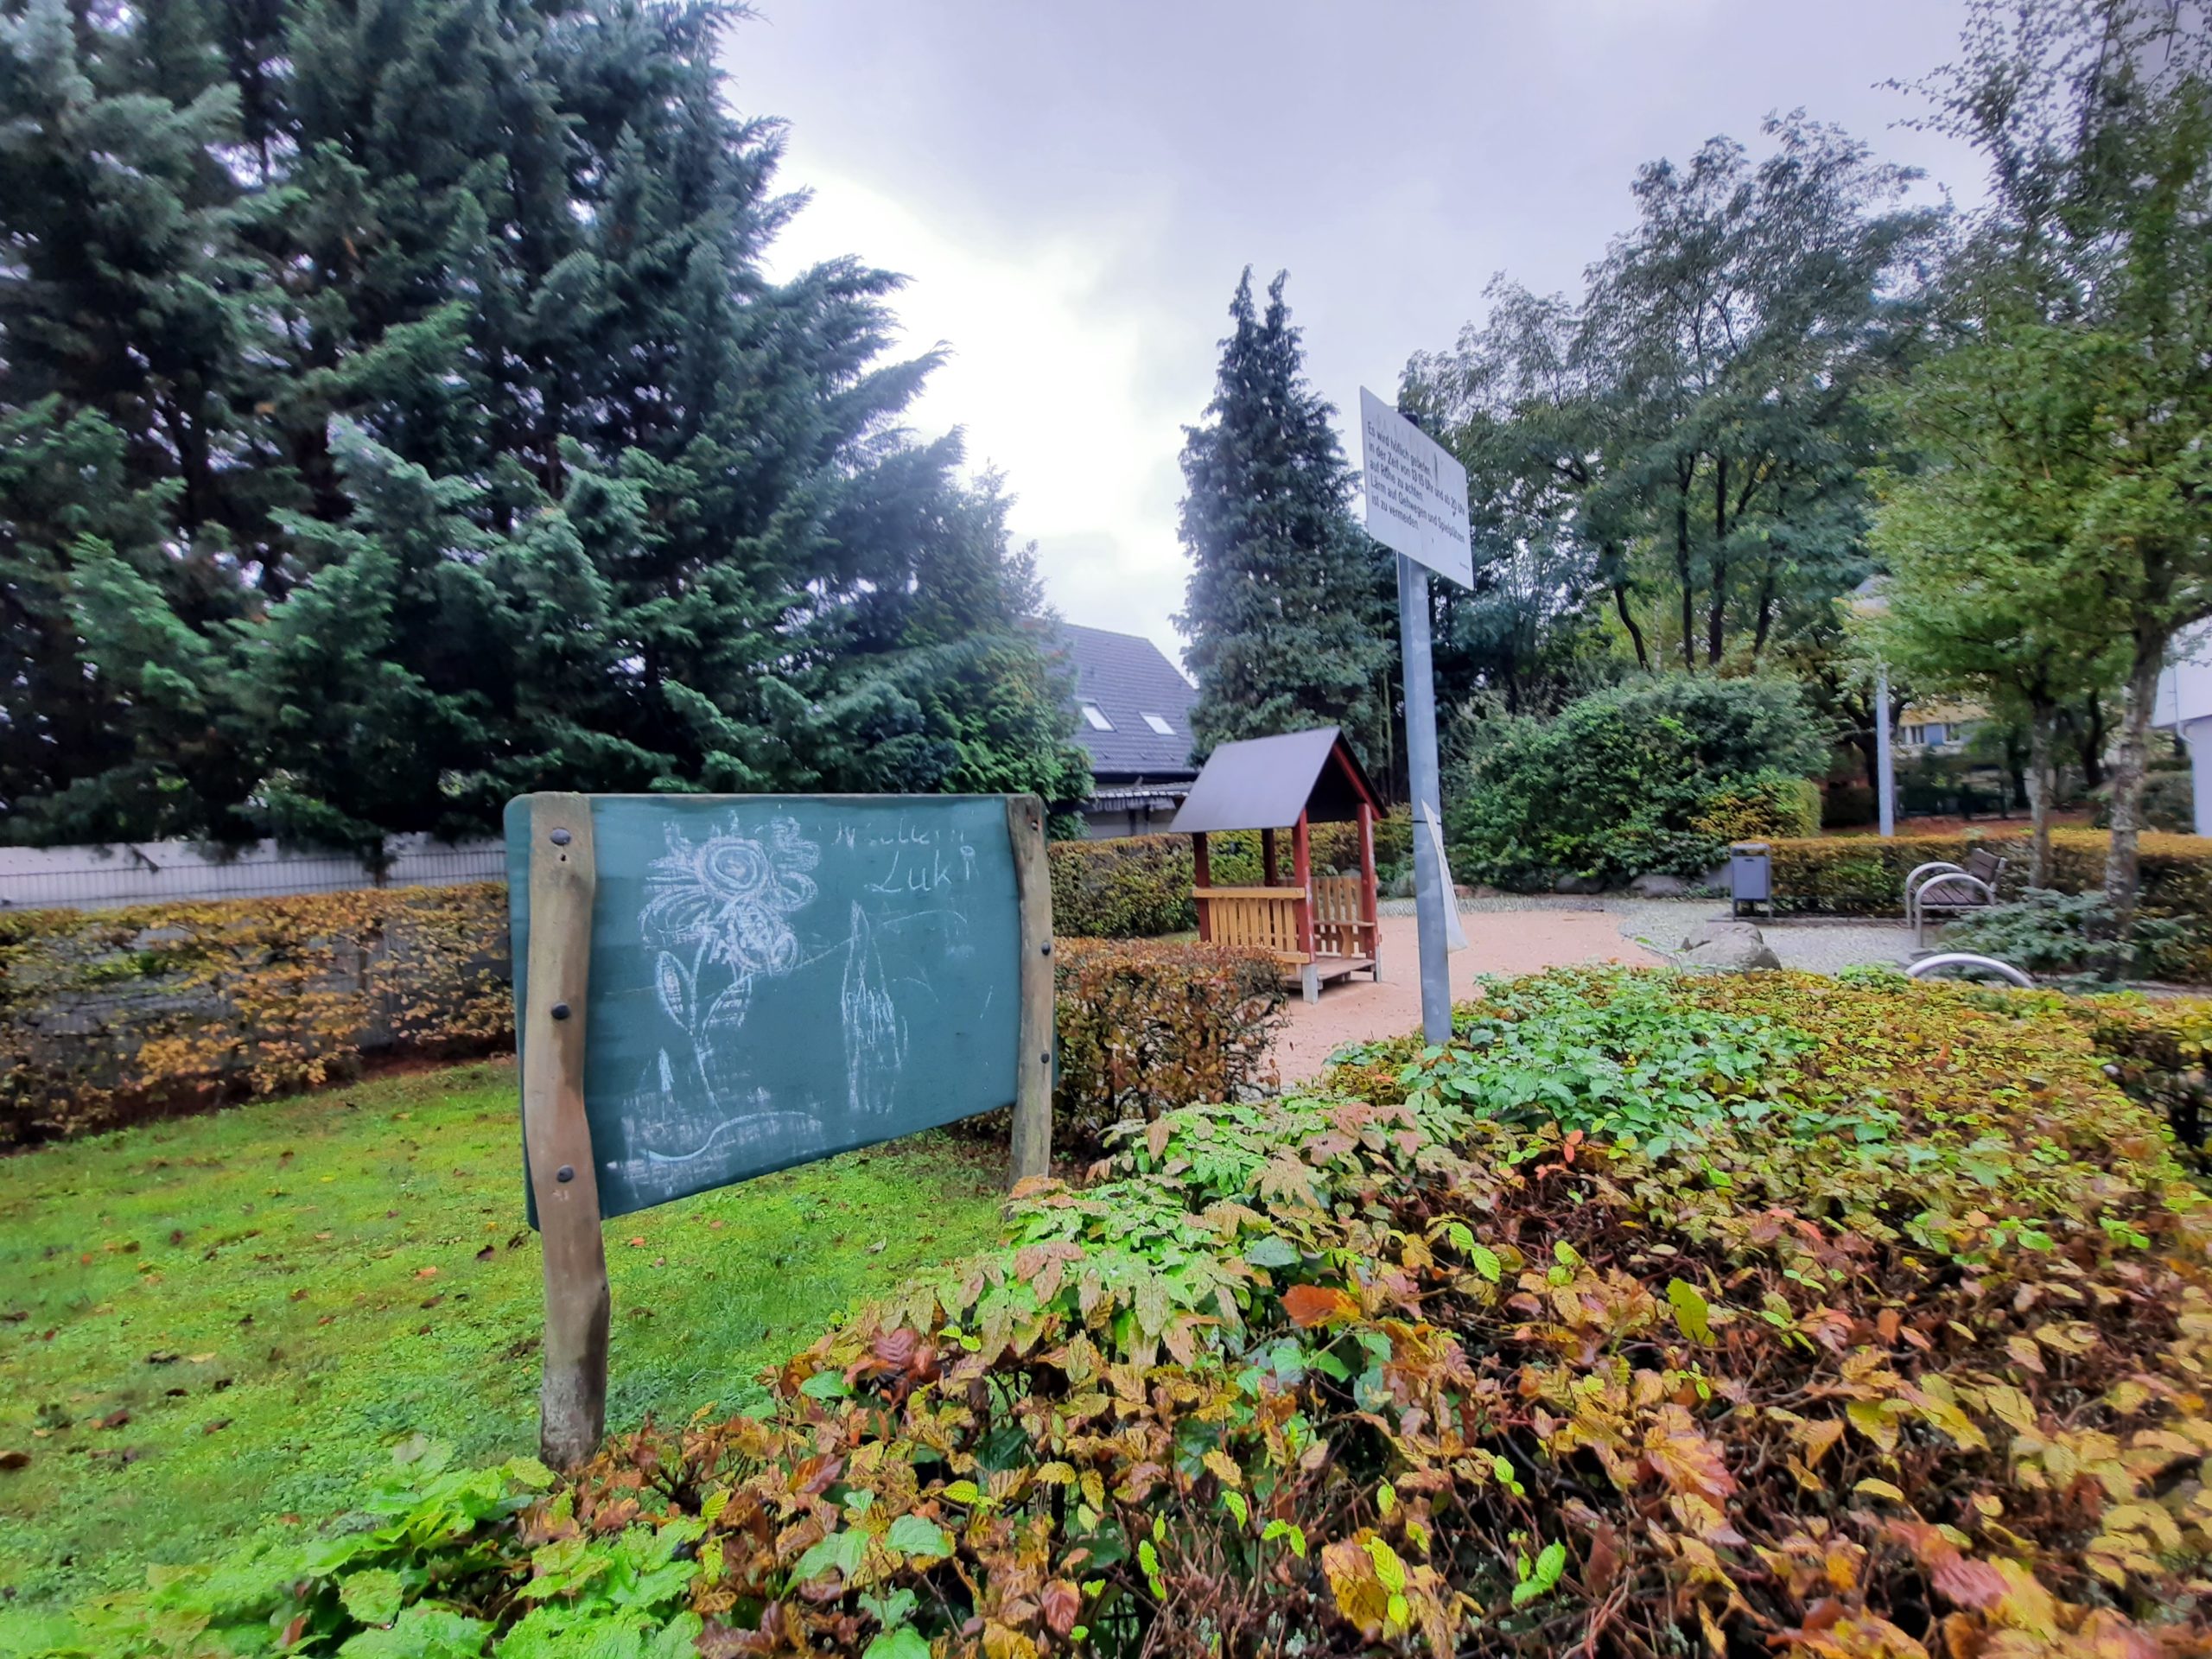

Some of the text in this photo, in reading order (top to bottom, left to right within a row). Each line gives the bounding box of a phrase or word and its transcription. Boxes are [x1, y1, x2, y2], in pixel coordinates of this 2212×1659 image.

[1370, 460, 1379, 474] auf
[1376, 445, 1386, 462] der
[1388, 451, 1399, 470] Zeit
[1401, 463, 1410, 477] von
[1388, 486, 1397, 501] auf
[1381, 499, 1388, 512] zu
